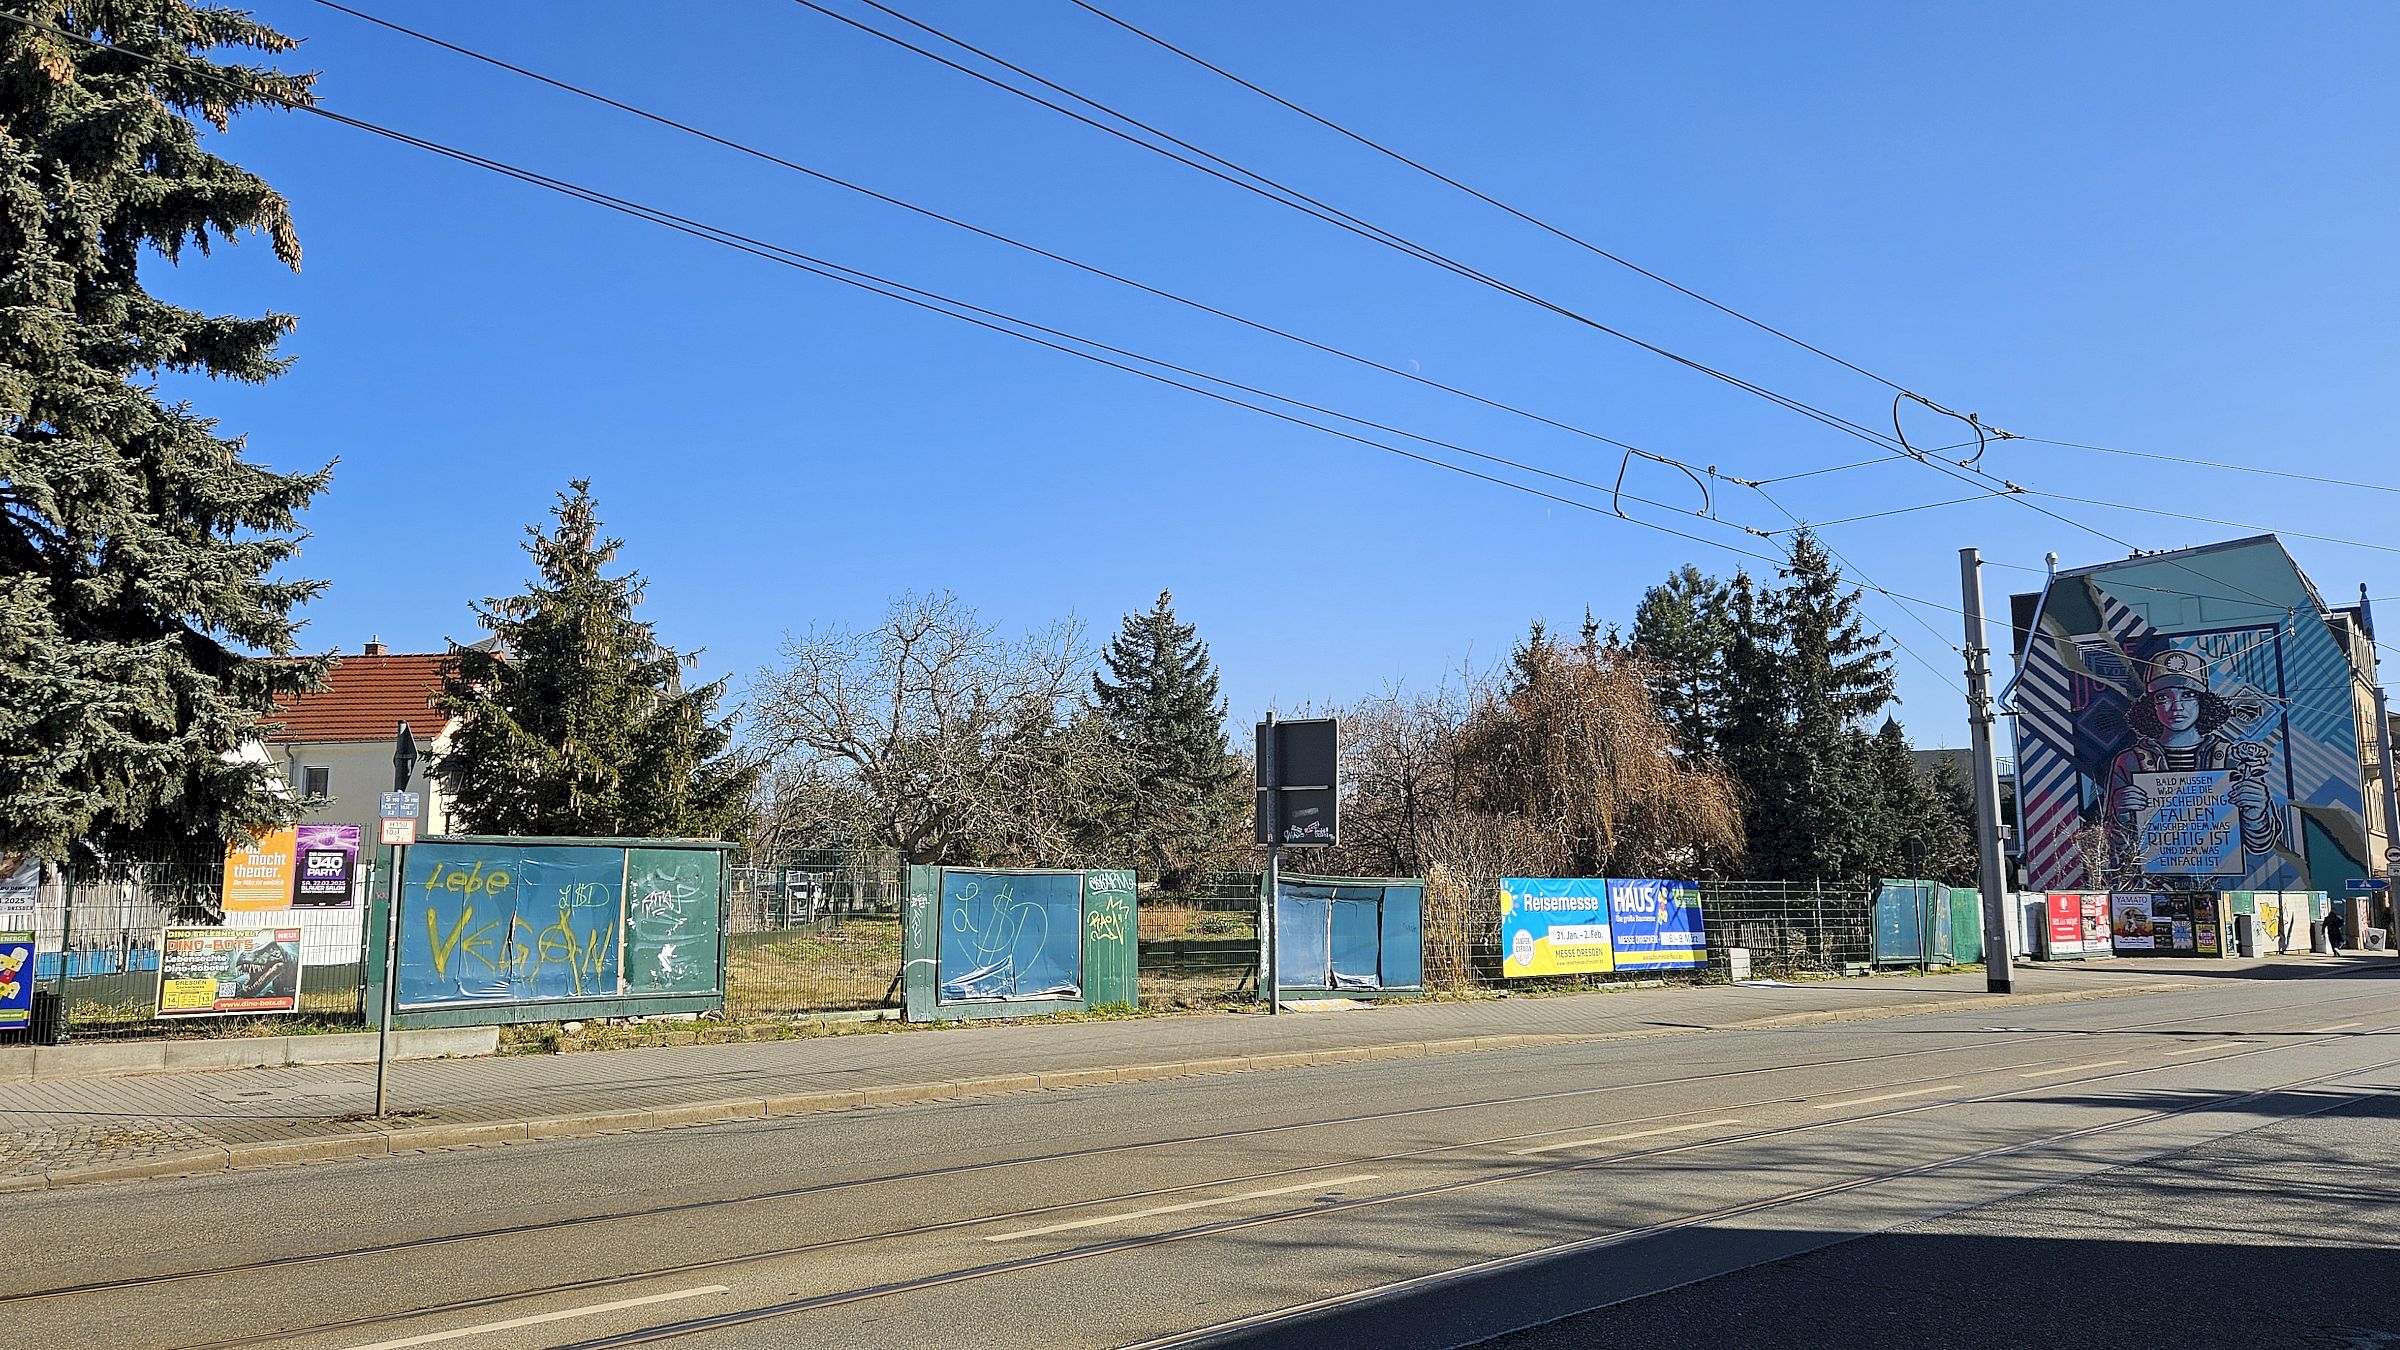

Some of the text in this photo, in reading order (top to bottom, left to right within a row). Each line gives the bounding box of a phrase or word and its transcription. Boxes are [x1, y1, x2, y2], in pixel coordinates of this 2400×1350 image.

[2156, 778, 2177, 786] BALD
[2176, 786, 2197, 794] ALLE
[2200, 785, 2213, 794] DIE
[2147, 795, 2227, 807] ENTSCHEIDUNG
[2148, 822, 2188, 831] ZWISCHEN
[2148, 831, 2230, 845] RICHTIG IST
[2160, 847, 2177, 855] UND
[248, 852, 286, 866] macht
[2160, 857, 2220, 866] EINFACH IST
[233, 864, 281, 878] theater.
[307, 868, 343, 877] PARTY
[425, 861, 511, 895] Lebe
[1523, 891, 1600, 912] Reisemesse
[1612, 886, 1655, 913] HAUS
[277, 930, 298, 939] NEU!
[1617, 936, 1635, 944] MESSE
[166, 939, 254, 951] DINO-BOTS
[1555, 948, 1604, 958] MESSE DRESDEN
[165, 955, 228, 963] Lebensechte
[164, 964, 230, 973] Dino-Roboter
[220, 1000, 287, 1008] www.dino-bots.de
